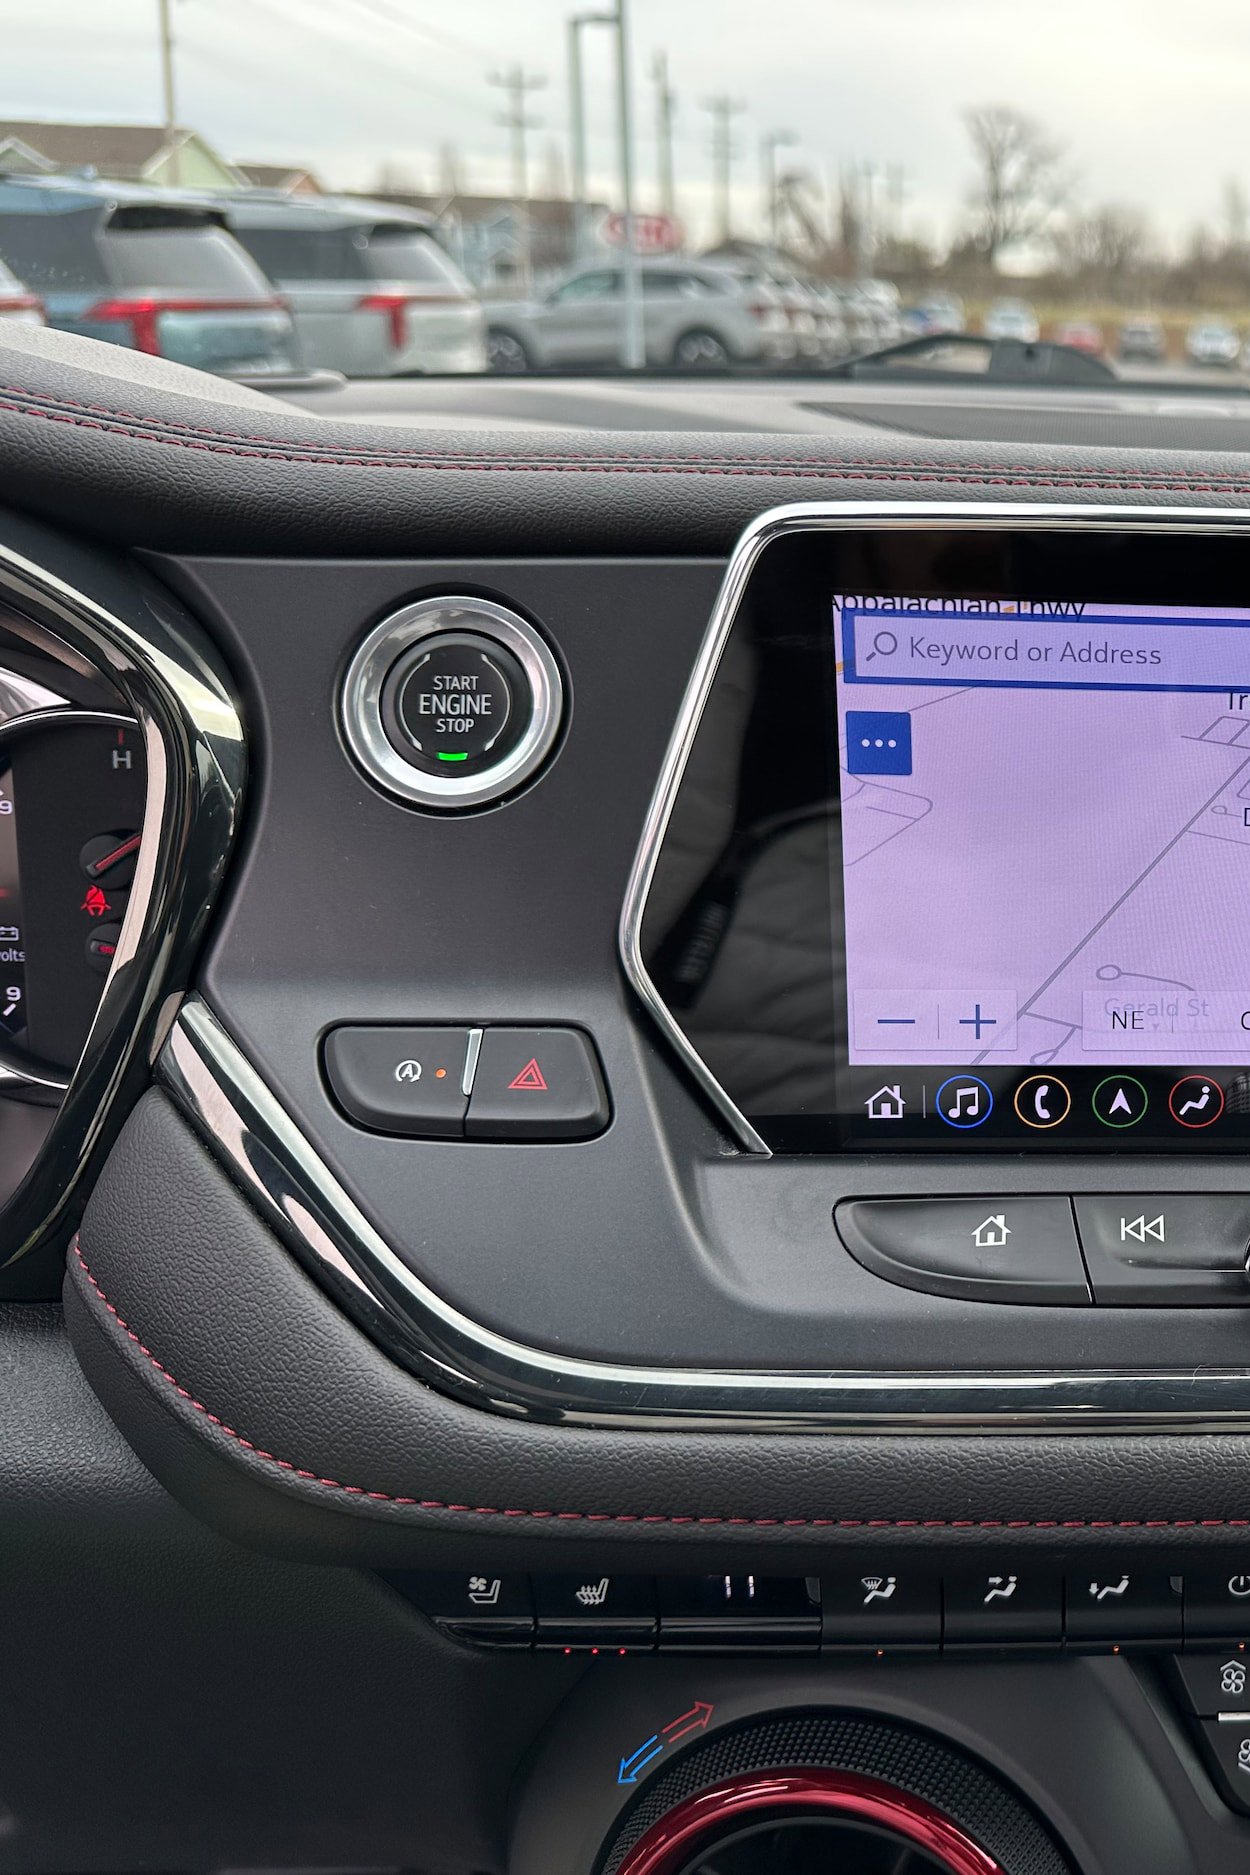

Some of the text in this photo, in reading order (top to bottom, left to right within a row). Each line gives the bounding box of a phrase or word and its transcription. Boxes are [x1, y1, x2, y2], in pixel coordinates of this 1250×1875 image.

[909, 636, 1162, 666] Keyword or Address
[433, 675, 479, 691] START
[419, 693, 493, 716] ENGINE
[436, 718, 475, 733] STOP
[112, 750, 132, 770] H
[6, 987, 21, 1001] 9
[1111, 1010, 1145, 1030] NE
